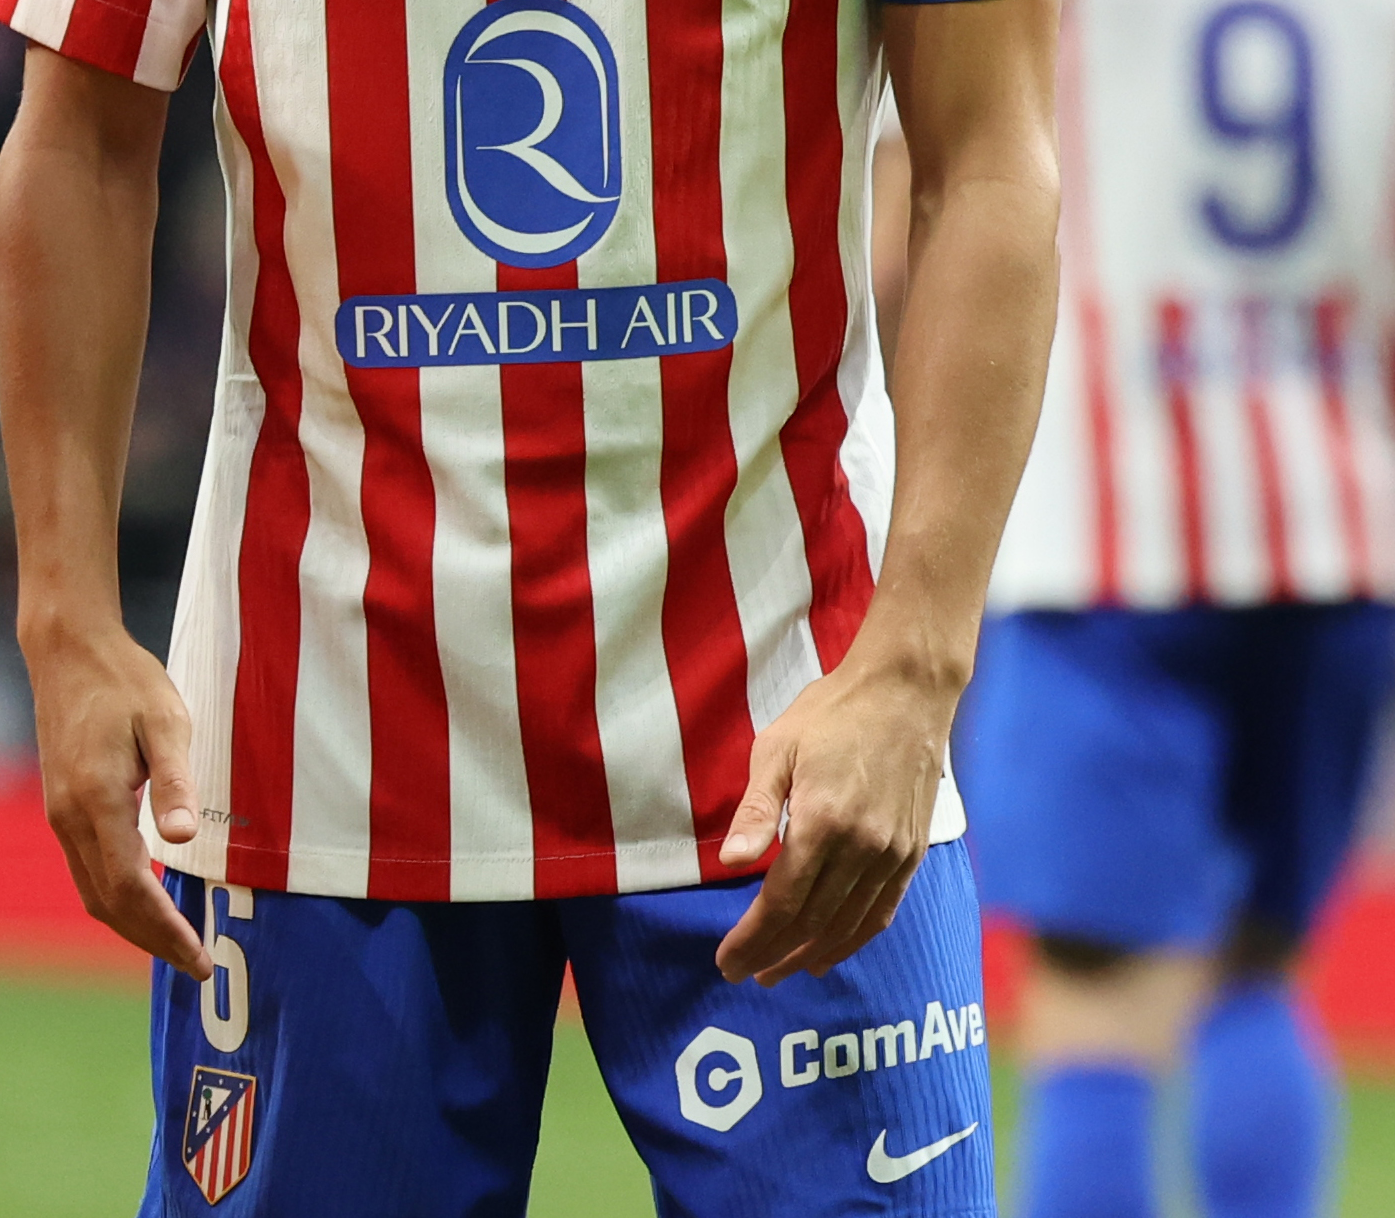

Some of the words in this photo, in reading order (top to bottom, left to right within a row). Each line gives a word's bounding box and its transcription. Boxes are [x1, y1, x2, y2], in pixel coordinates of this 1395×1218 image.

[1196, 0, 1317, 253] 9
[354, 298, 599, 359] RIYADH
[620, 288, 726, 350] AIR
[201, 881, 254, 1053] 6
[779, 1000, 985, 1089] ComAve
